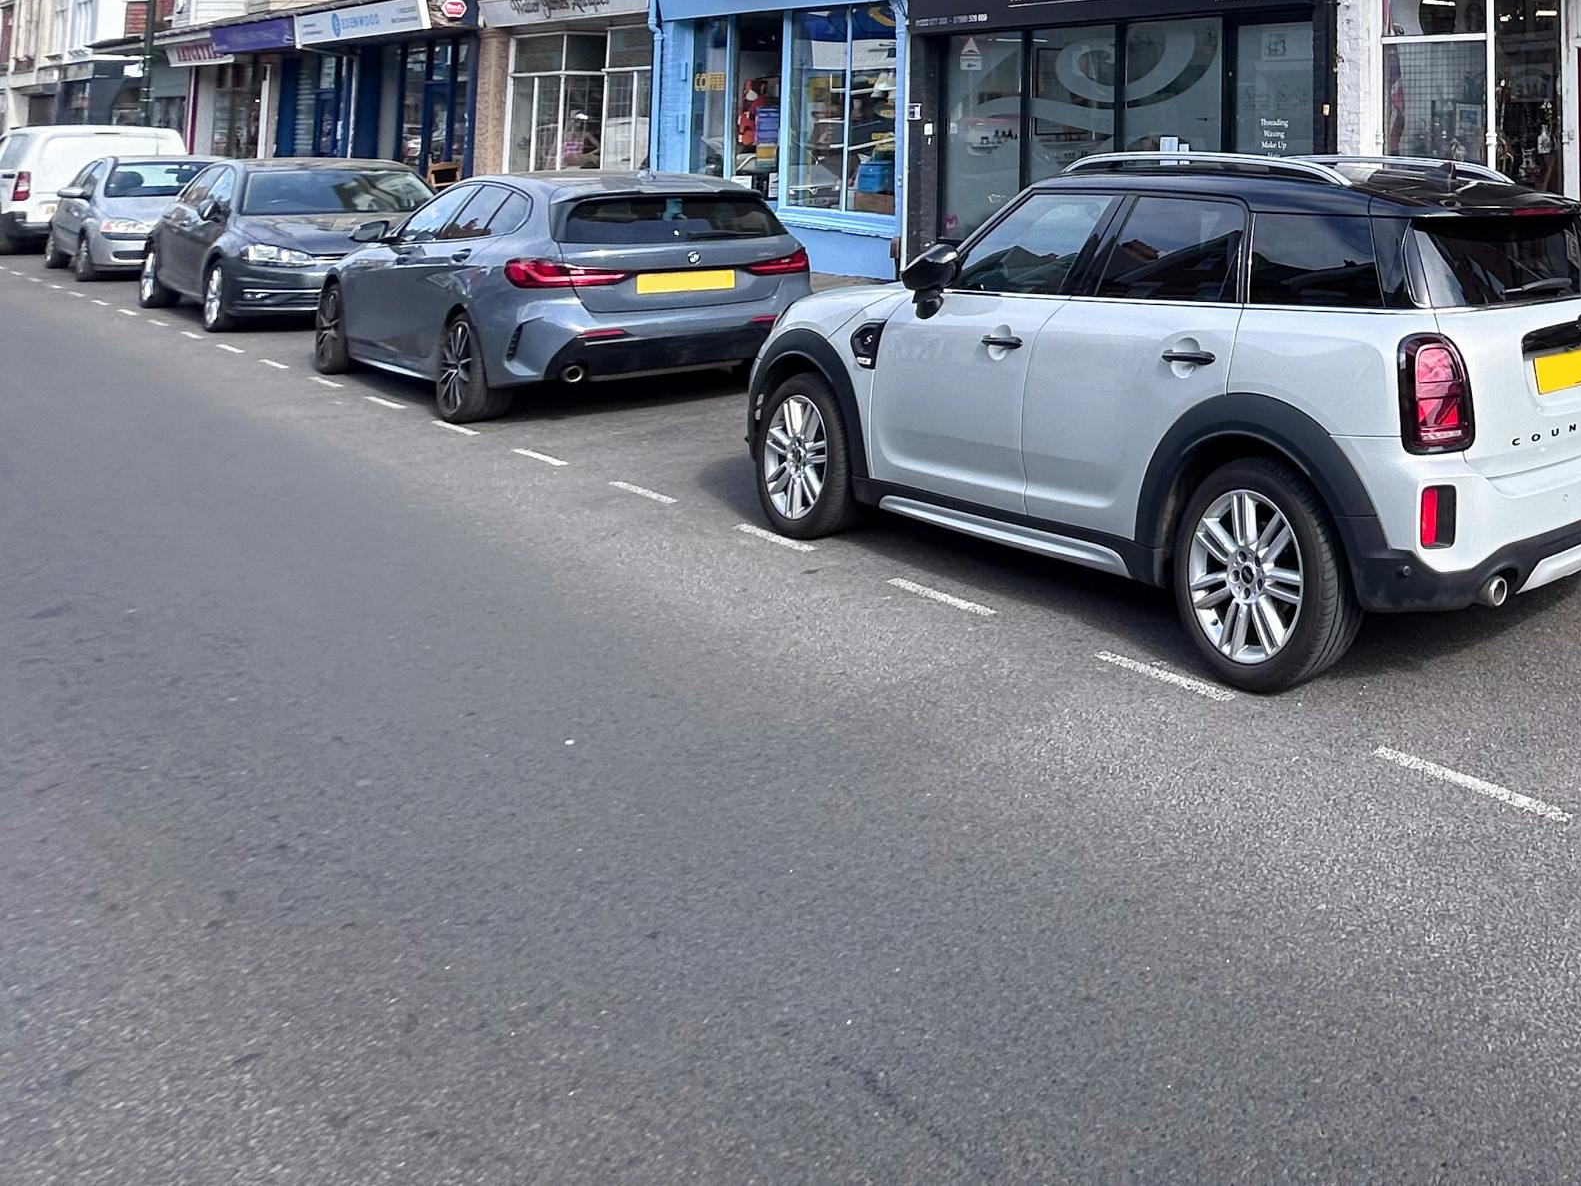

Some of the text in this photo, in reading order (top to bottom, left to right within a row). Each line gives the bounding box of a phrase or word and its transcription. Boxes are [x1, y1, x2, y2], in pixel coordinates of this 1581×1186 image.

[695, 72, 725, 92] COFFEE
[1261, 140, 1288, 151] Make Up
